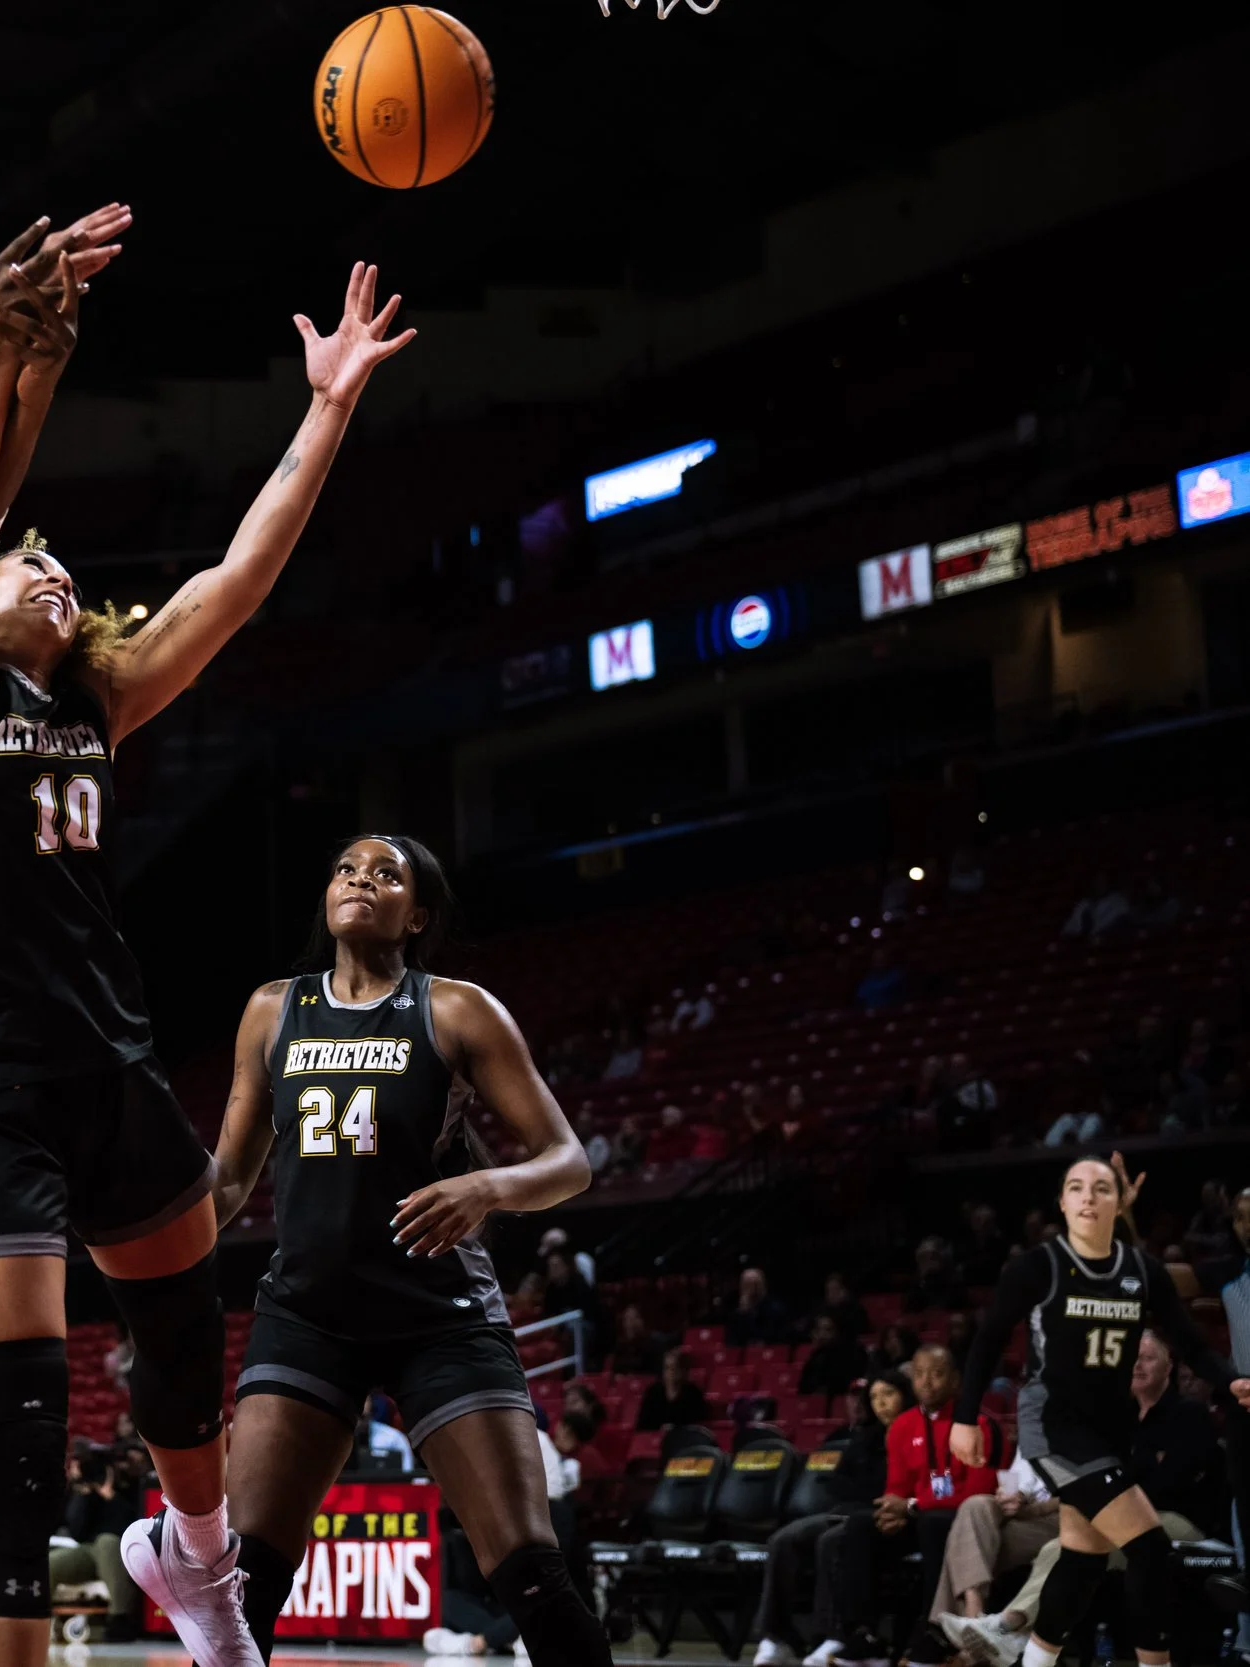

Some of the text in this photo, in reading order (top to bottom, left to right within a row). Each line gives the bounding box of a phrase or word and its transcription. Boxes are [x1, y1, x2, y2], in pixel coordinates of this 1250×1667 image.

[322, 66, 350, 156] NCAA
[879, 551, 916, 611] M
[606, 628, 635, 678] M
[30, 772, 101, 854] 10
[283, 1037, 412, 1079] RETRIEVERS
[299, 1086, 378, 1157] 24
[1064, 1295, 1143, 1324] RETRIEVERS
[1082, 1326, 1129, 1369] 15
[312, 1513, 420, 1538] OF THE
